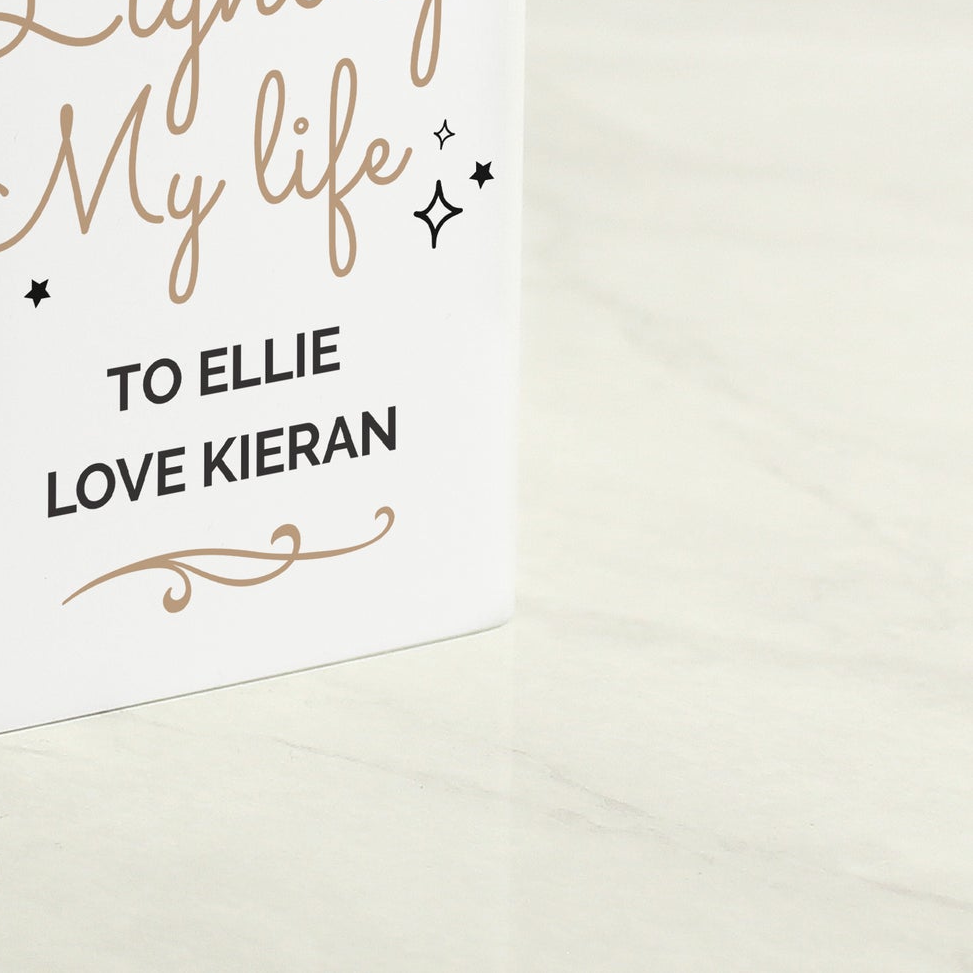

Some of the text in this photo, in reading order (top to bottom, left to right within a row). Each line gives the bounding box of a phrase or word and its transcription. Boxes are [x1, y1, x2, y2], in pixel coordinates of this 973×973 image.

[254, 58, 412, 277] life
[107, 326, 340, 412] TO ELLIE
[48, 406, 396, 518] LOVE KIERAN
